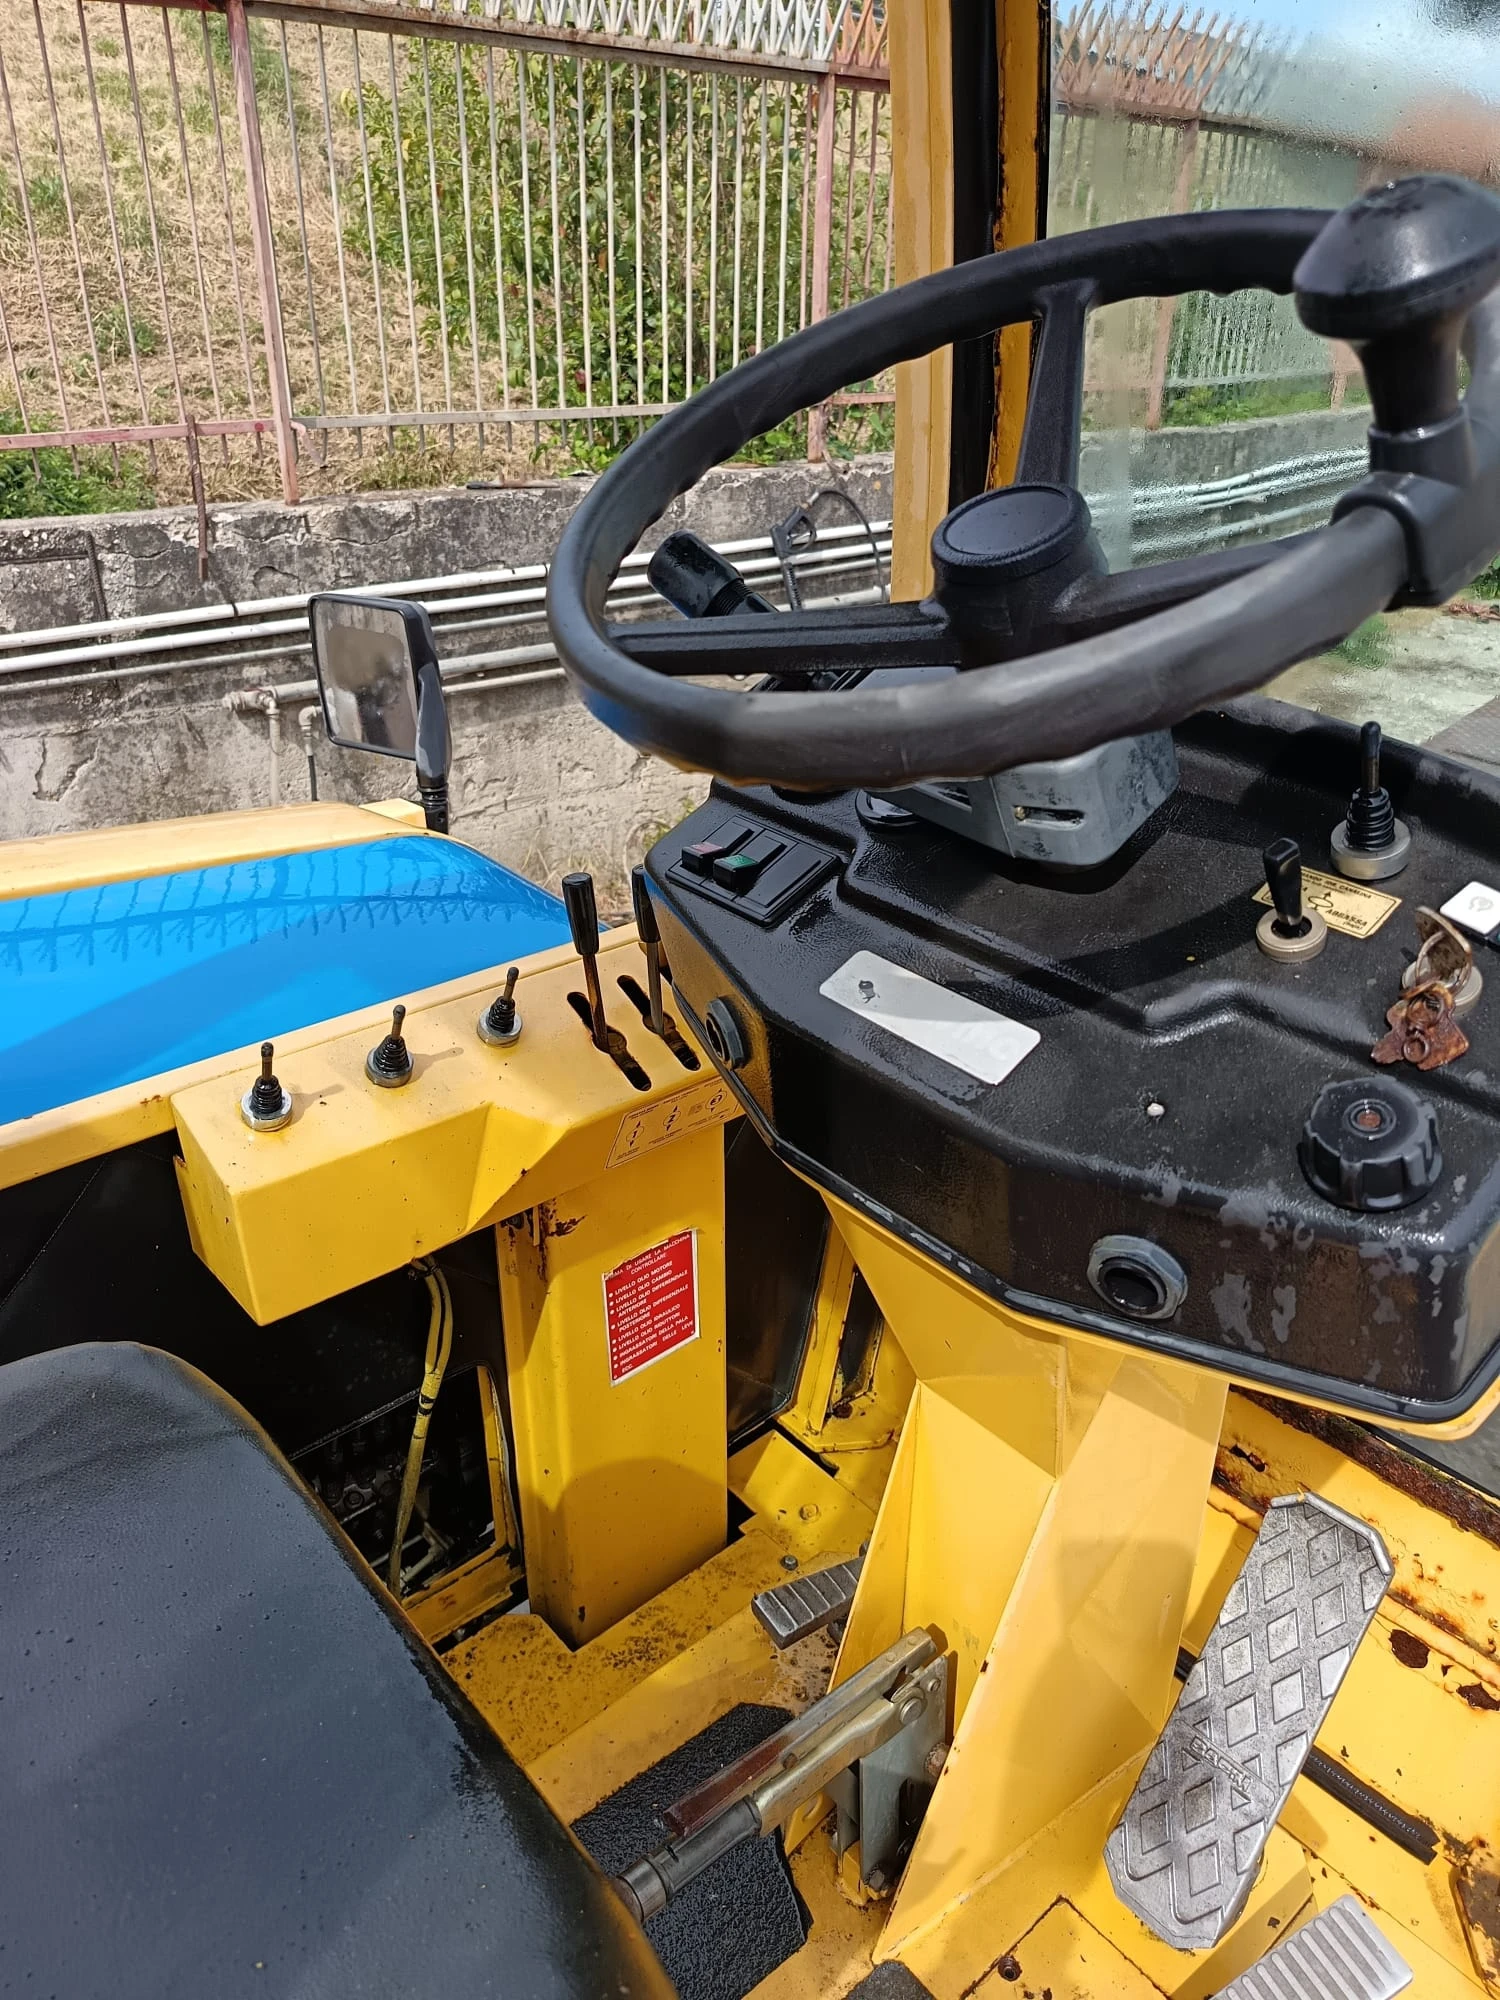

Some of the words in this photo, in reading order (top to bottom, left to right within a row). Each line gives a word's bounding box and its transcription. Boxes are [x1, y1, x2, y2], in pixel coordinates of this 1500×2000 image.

[626, 1263, 633, 1271] DI
[634, 1253, 652, 1266] USARE
[663, 1234, 690, 1250] MACCHINA
[630, 1252, 667, 1275] CONTROLLARE
[614, 1280, 636, 1296] LIVELLO
[637, 1273, 650, 1283] OLIO
[650, 1260, 673, 1276] MOTORE
[615, 1289, 637, 1304] LIVELLO
[637, 1281, 650, 1292] OLIO
[651, 1269, 673, 1285] CAMBIO
[616, 1297, 637, 1312] LIVELLO
[638, 1289, 651, 1300] OLIO
[651, 1269, 688, 1293] DIFFERENZIALE
[617, 1312, 638, 1327] LIVELLO
[639, 1304, 652, 1315] OLIO
[652, 1284, 689, 1307] DIFFERENZIALE
[618, 1298, 647, 1318] ANTERIORE
[618, 1326, 639, 1342] LIVELLO
[640, 1319, 653, 1329] OLIO
[653, 1303, 681, 1322] IDRAULICO
[619, 1311, 651, 1333] POSTERIORE
[618, 1335, 639, 1350] LIVELLO
[640, 1327, 653, 1338] OLIO
[653, 1311, 680, 1330] RIDUTTORI
[619, 1333, 658, 1358] INGRASSATORI
[658, 1323, 674, 1336] DELLA
[675, 1315, 689, 1326] PALA
[619, 1341, 658, 1366] INGRASSATORI
[662, 1329, 677, 1342] DELLE
[681, 1320, 694, 1331] LEVE
